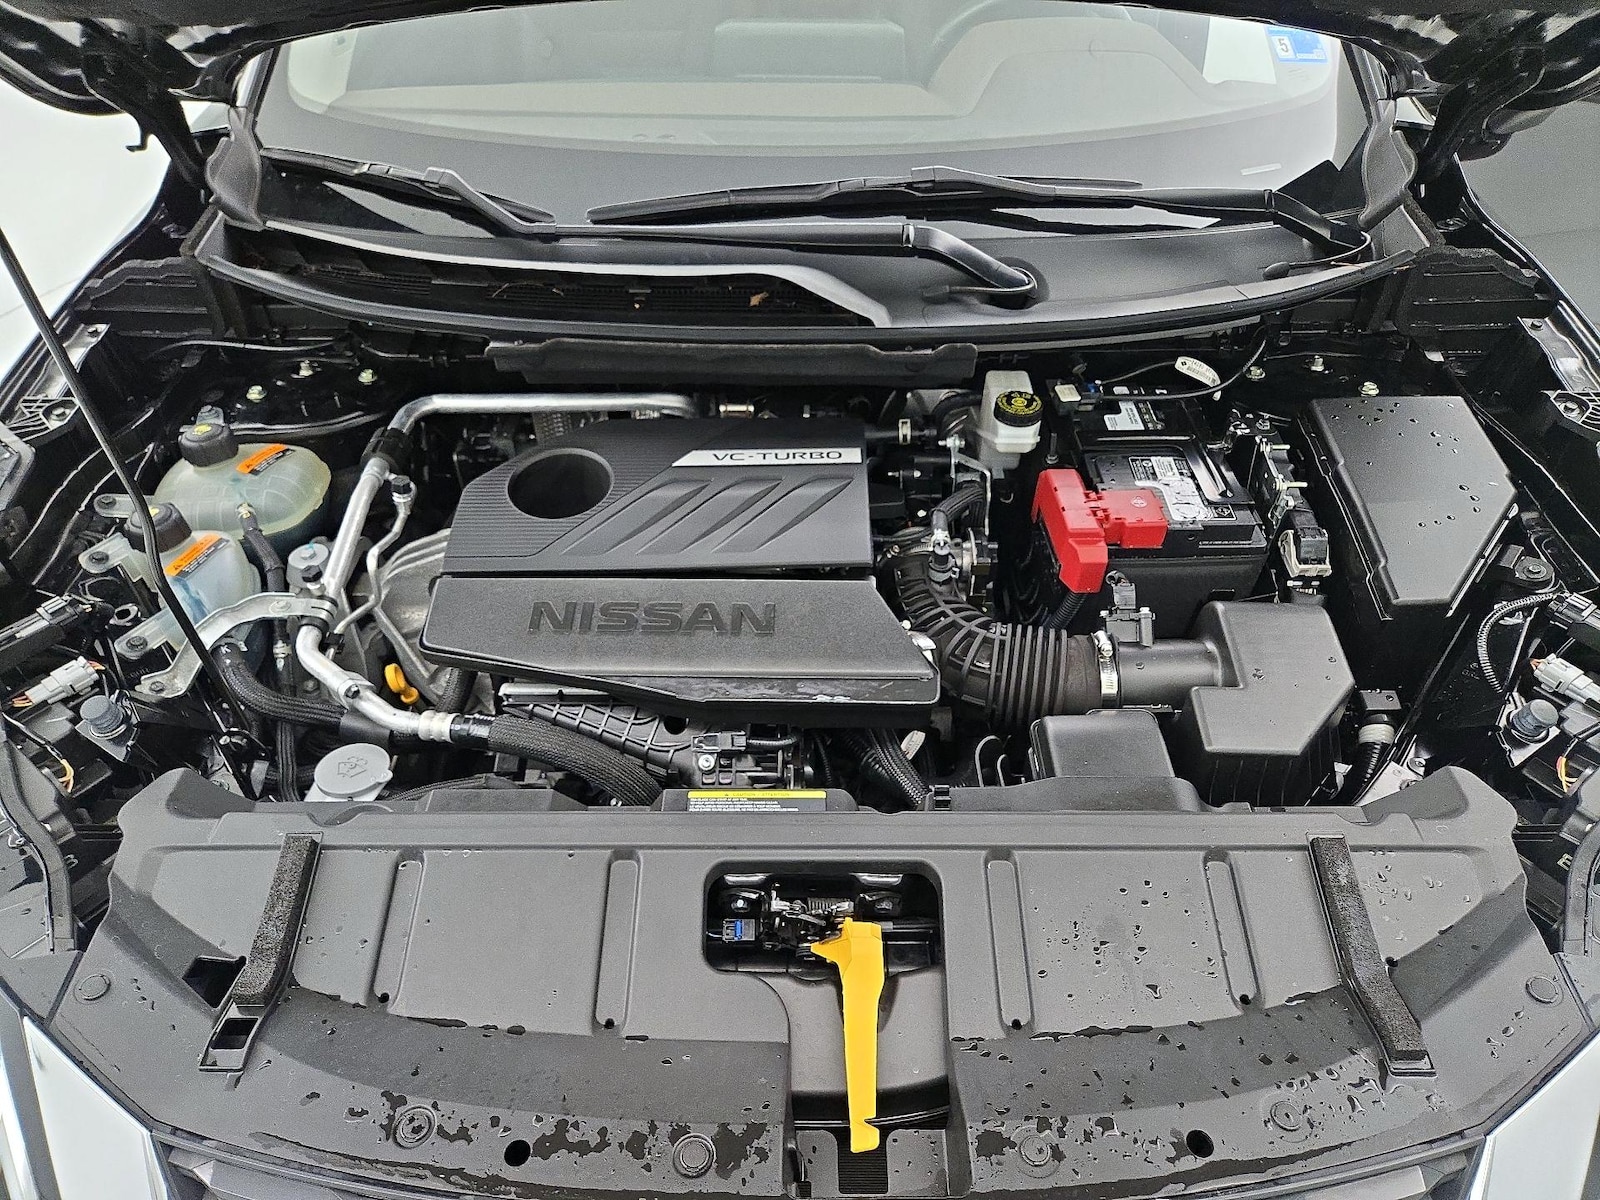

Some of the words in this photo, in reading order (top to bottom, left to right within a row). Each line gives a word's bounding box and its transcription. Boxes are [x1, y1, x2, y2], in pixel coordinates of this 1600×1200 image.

[1278, 38, 1289, 53] 5
[712, 450, 844, 462] VC-TURBO
[527, 600, 777, 635] NISSAN
